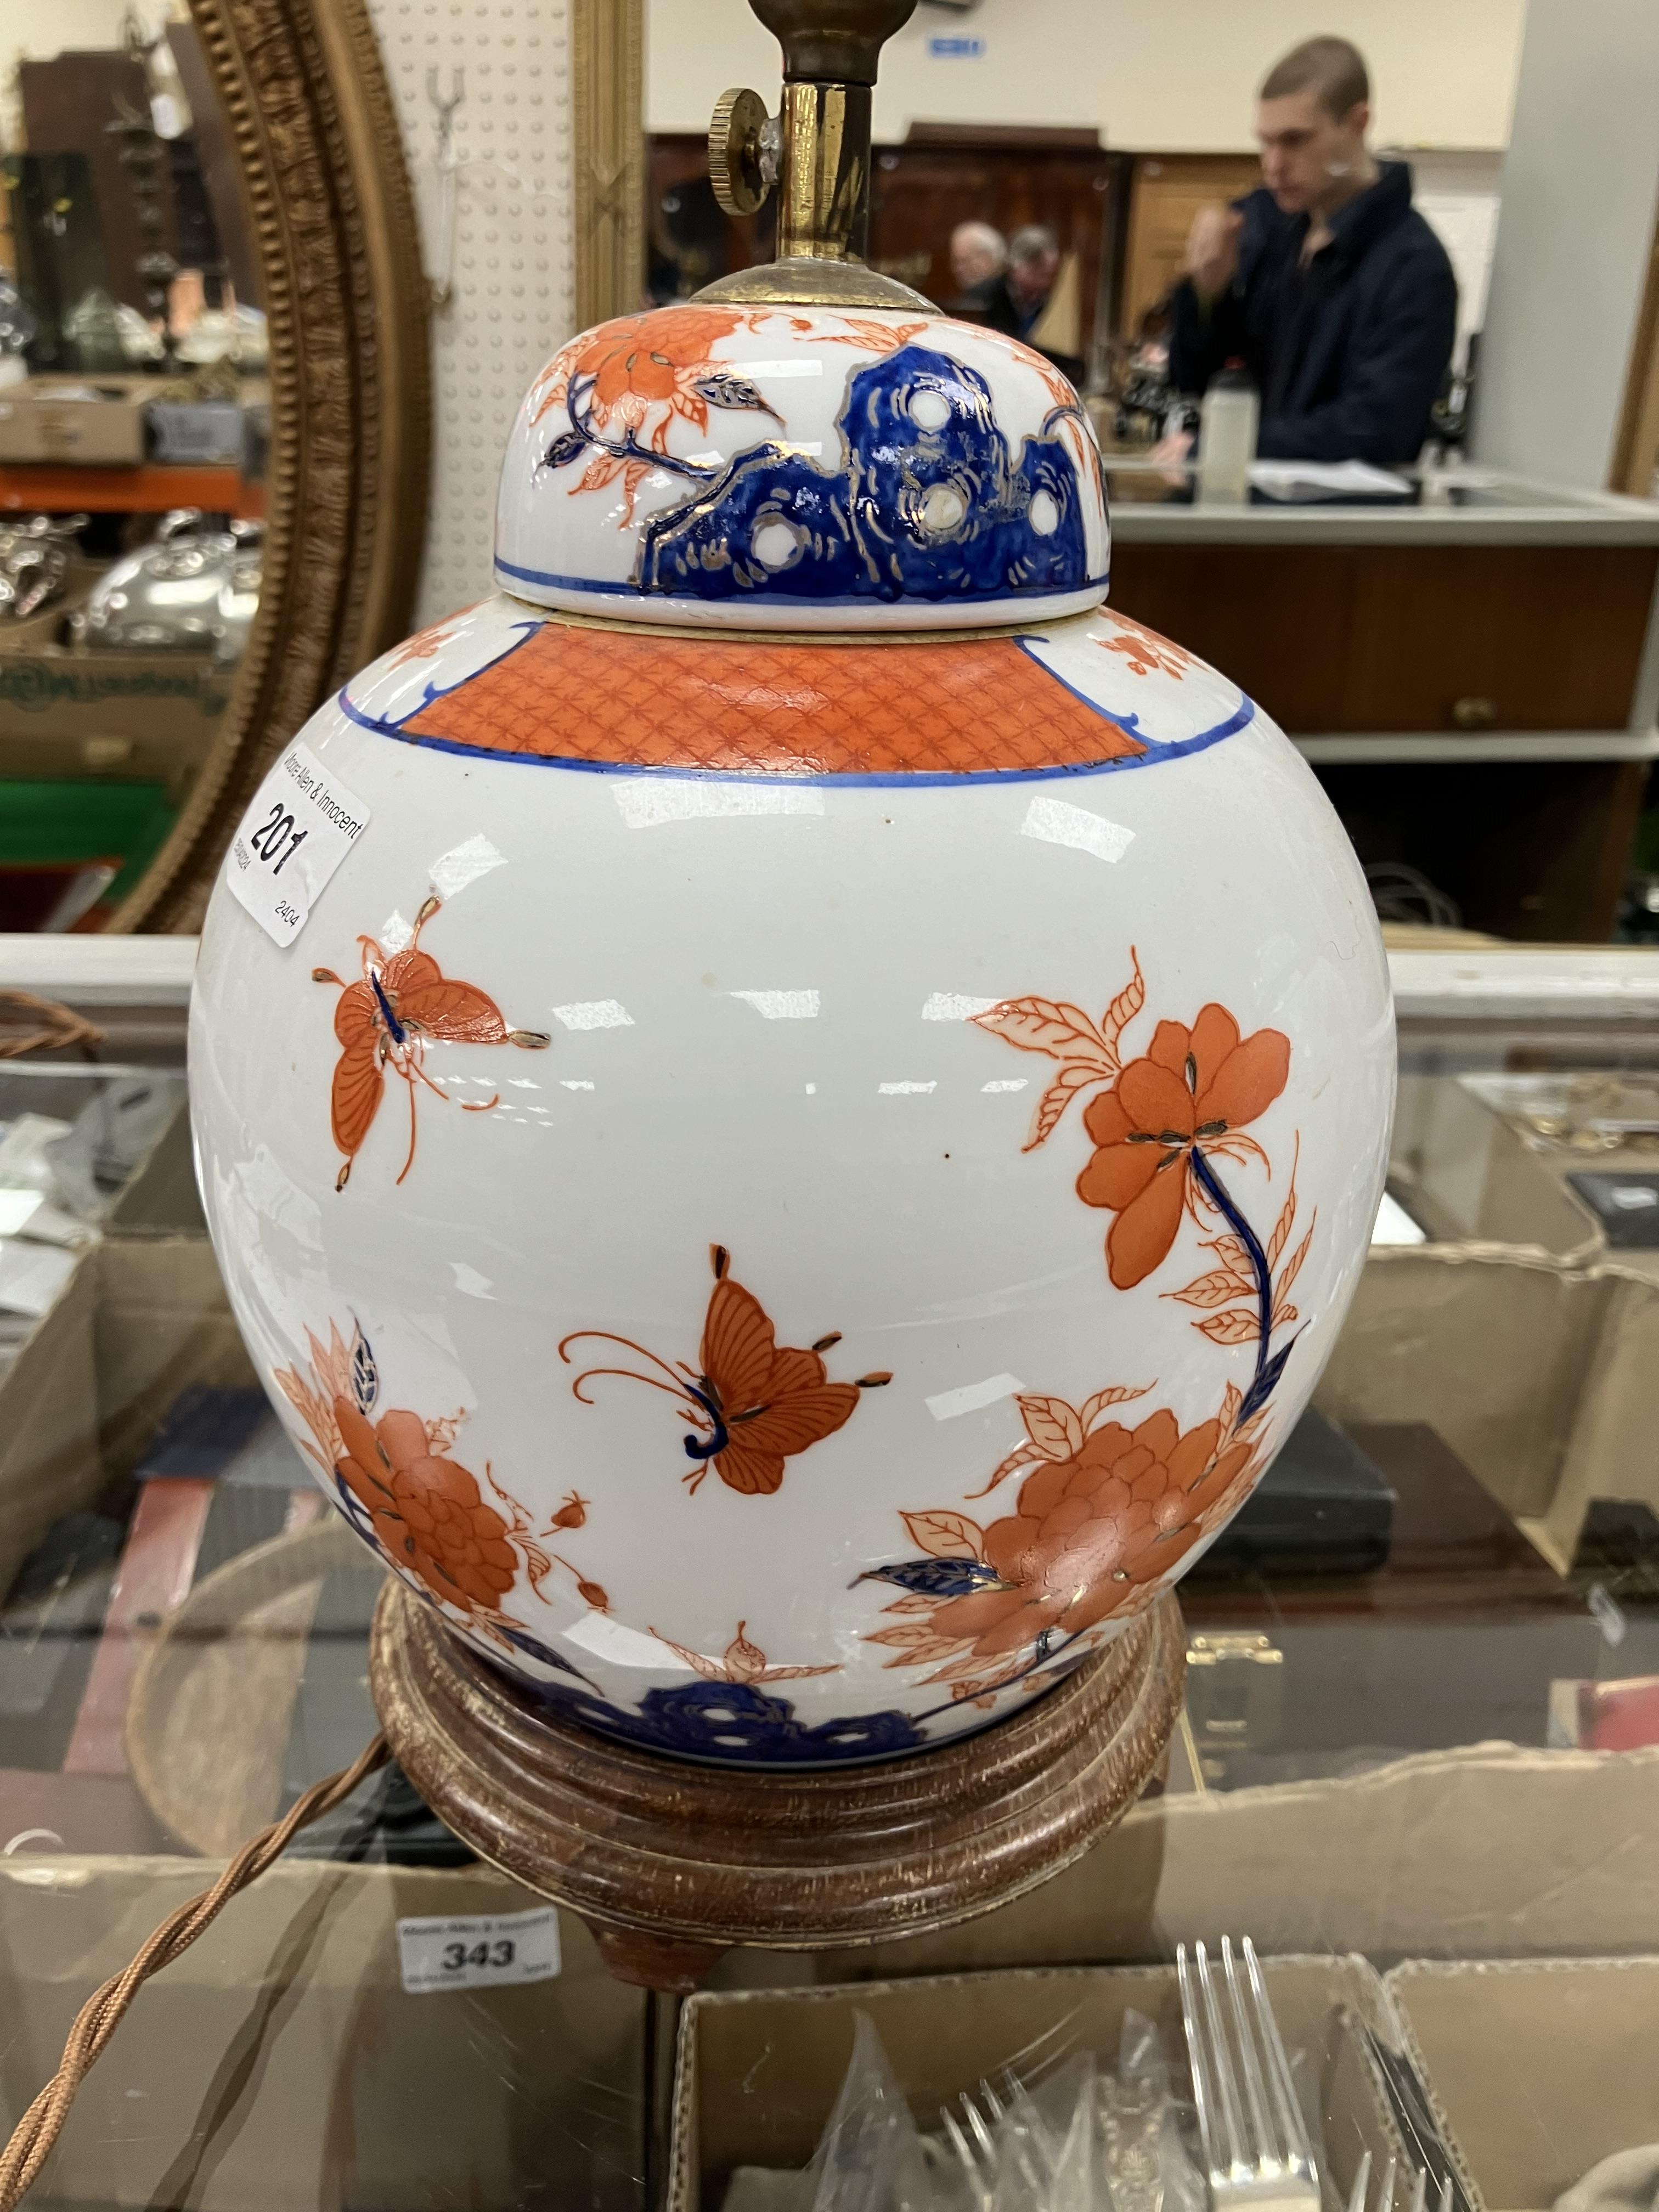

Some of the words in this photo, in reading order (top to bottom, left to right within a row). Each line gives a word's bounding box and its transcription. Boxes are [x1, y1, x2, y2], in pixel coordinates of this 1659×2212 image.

[295, 767, 314, 793] Allen
[309, 782, 324, 802] &
[316, 789, 363, 839] Innocent
[251, 803, 309, 876] 201
[274, 900, 300, 928] 2404
[443, 1939, 516, 1970] 343
